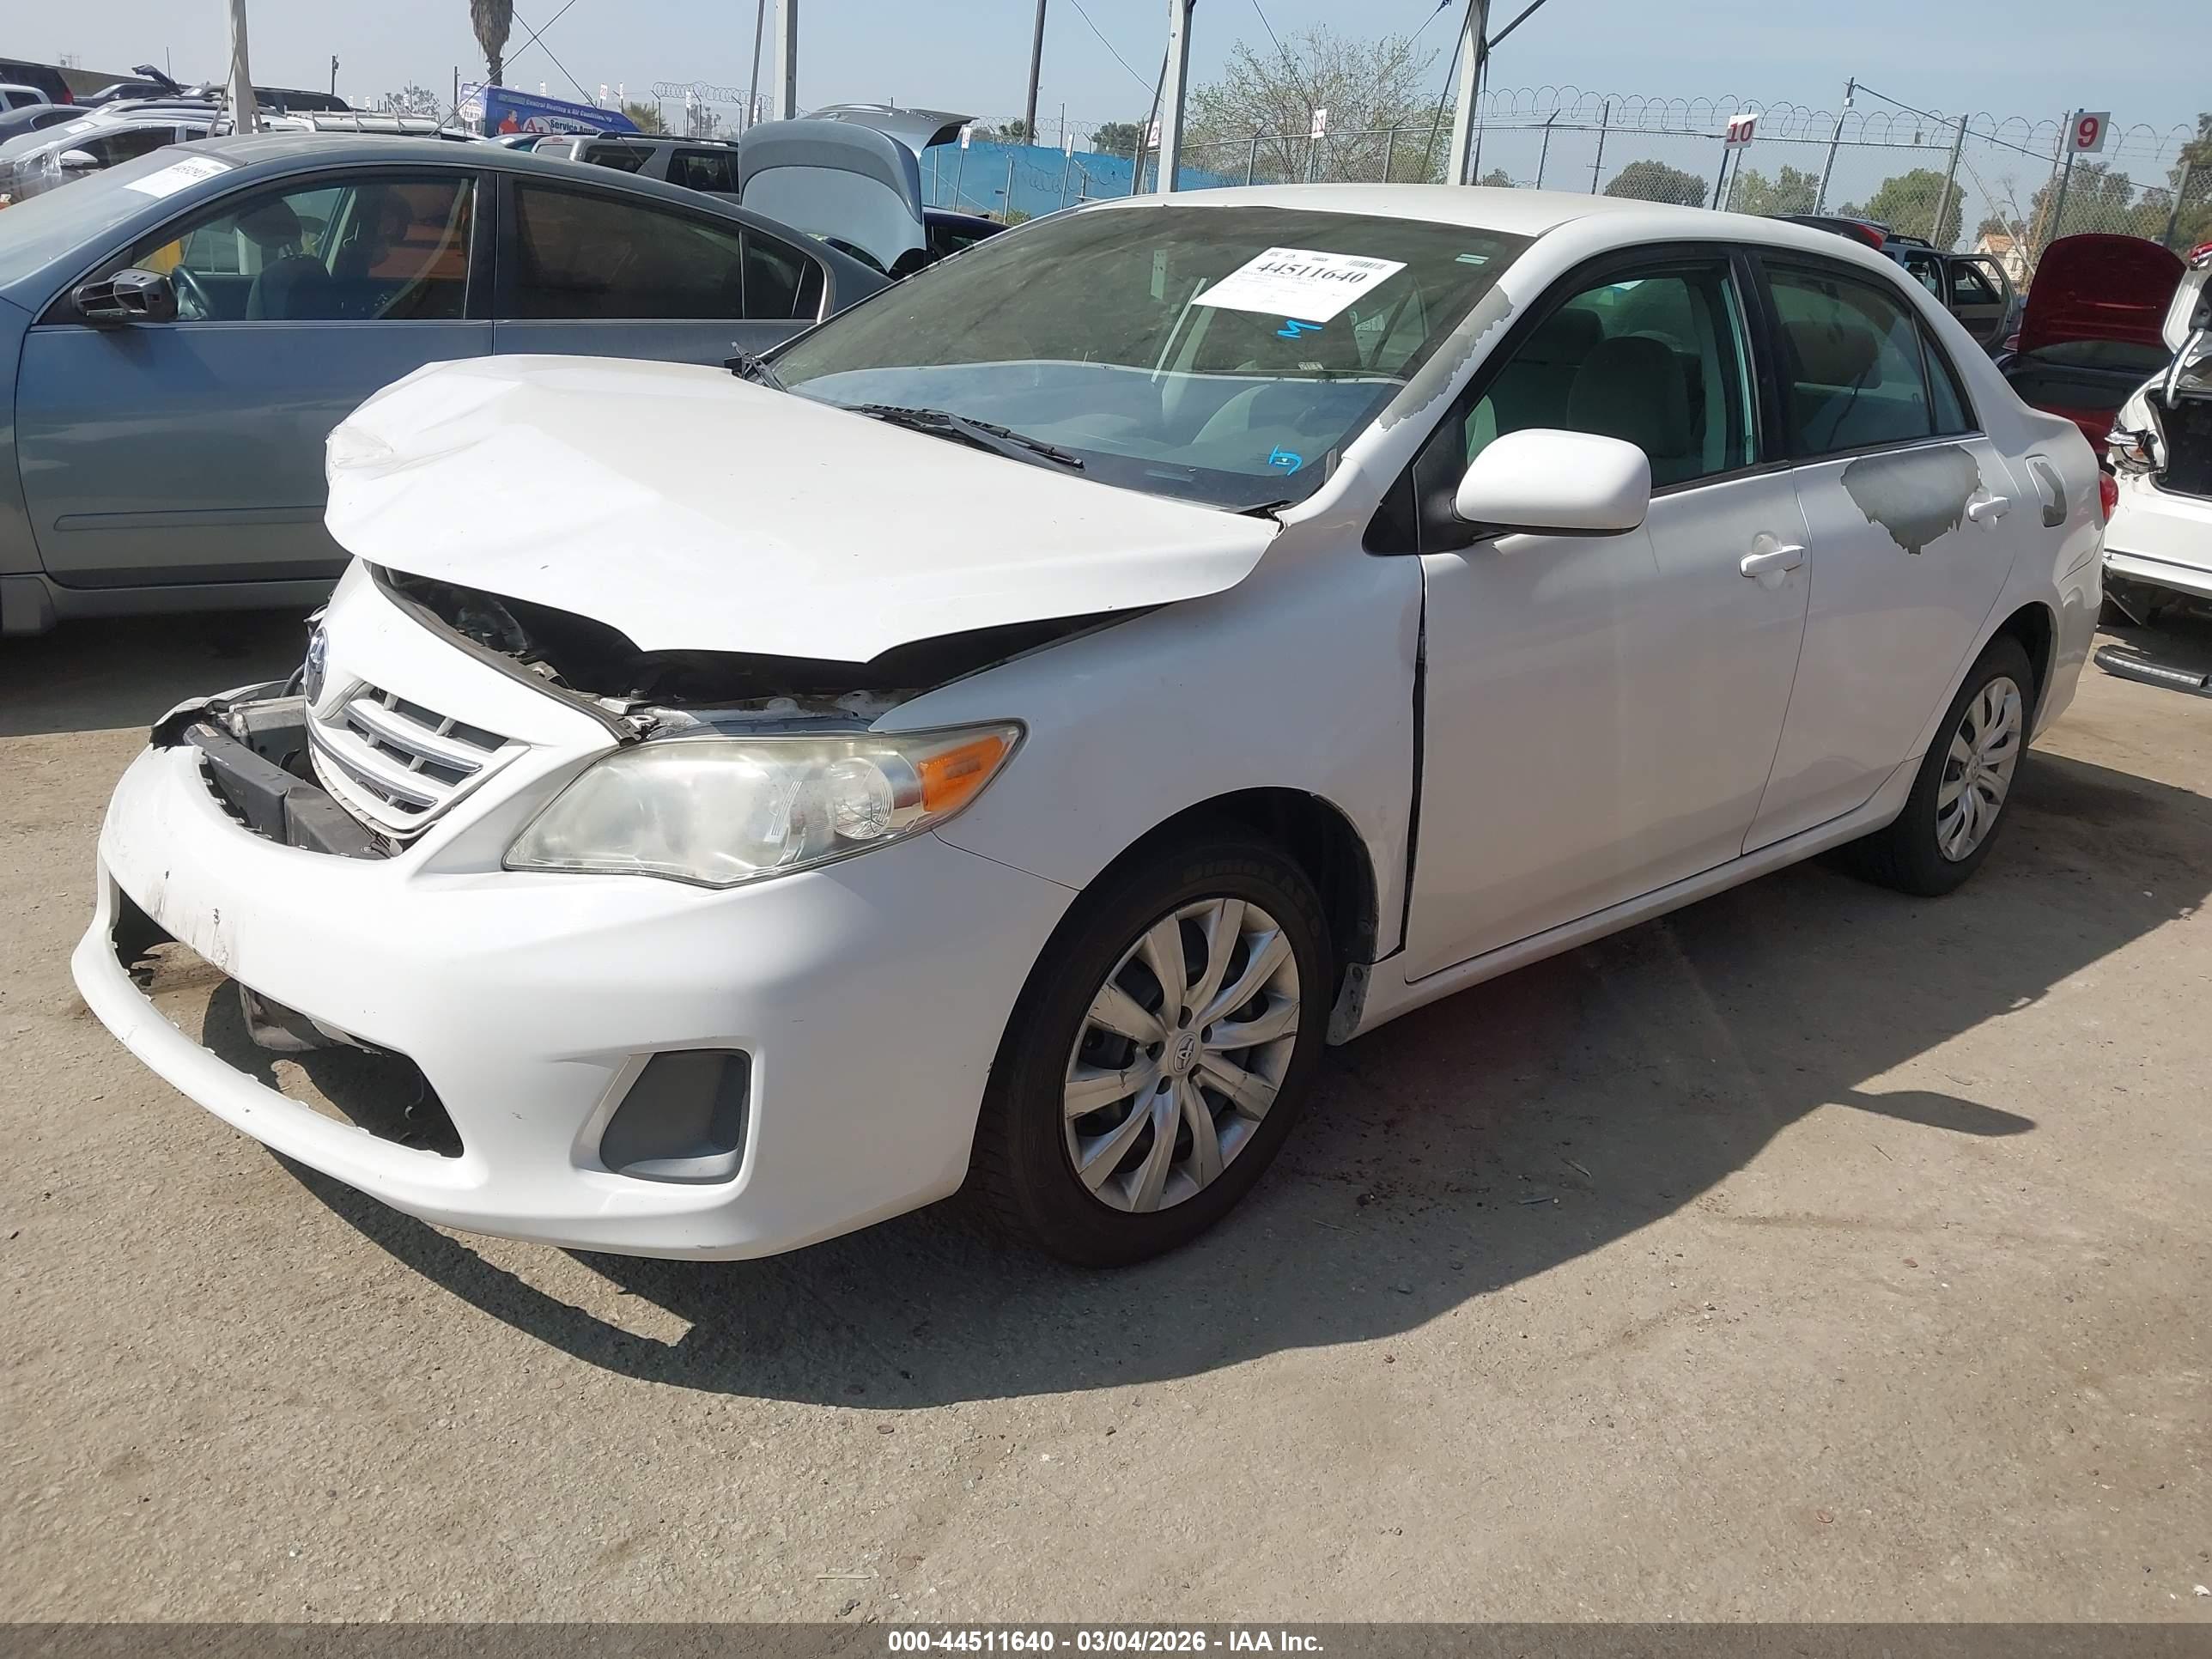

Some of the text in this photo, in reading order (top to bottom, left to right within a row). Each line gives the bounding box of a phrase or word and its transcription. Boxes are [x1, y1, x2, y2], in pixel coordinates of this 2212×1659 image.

[550, 118, 578, 133] Service
[1727, 121, 1753, 143] 10
[2077, 117, 2100, 148] 9
[1257, 261, 1368, 283] 44511640
